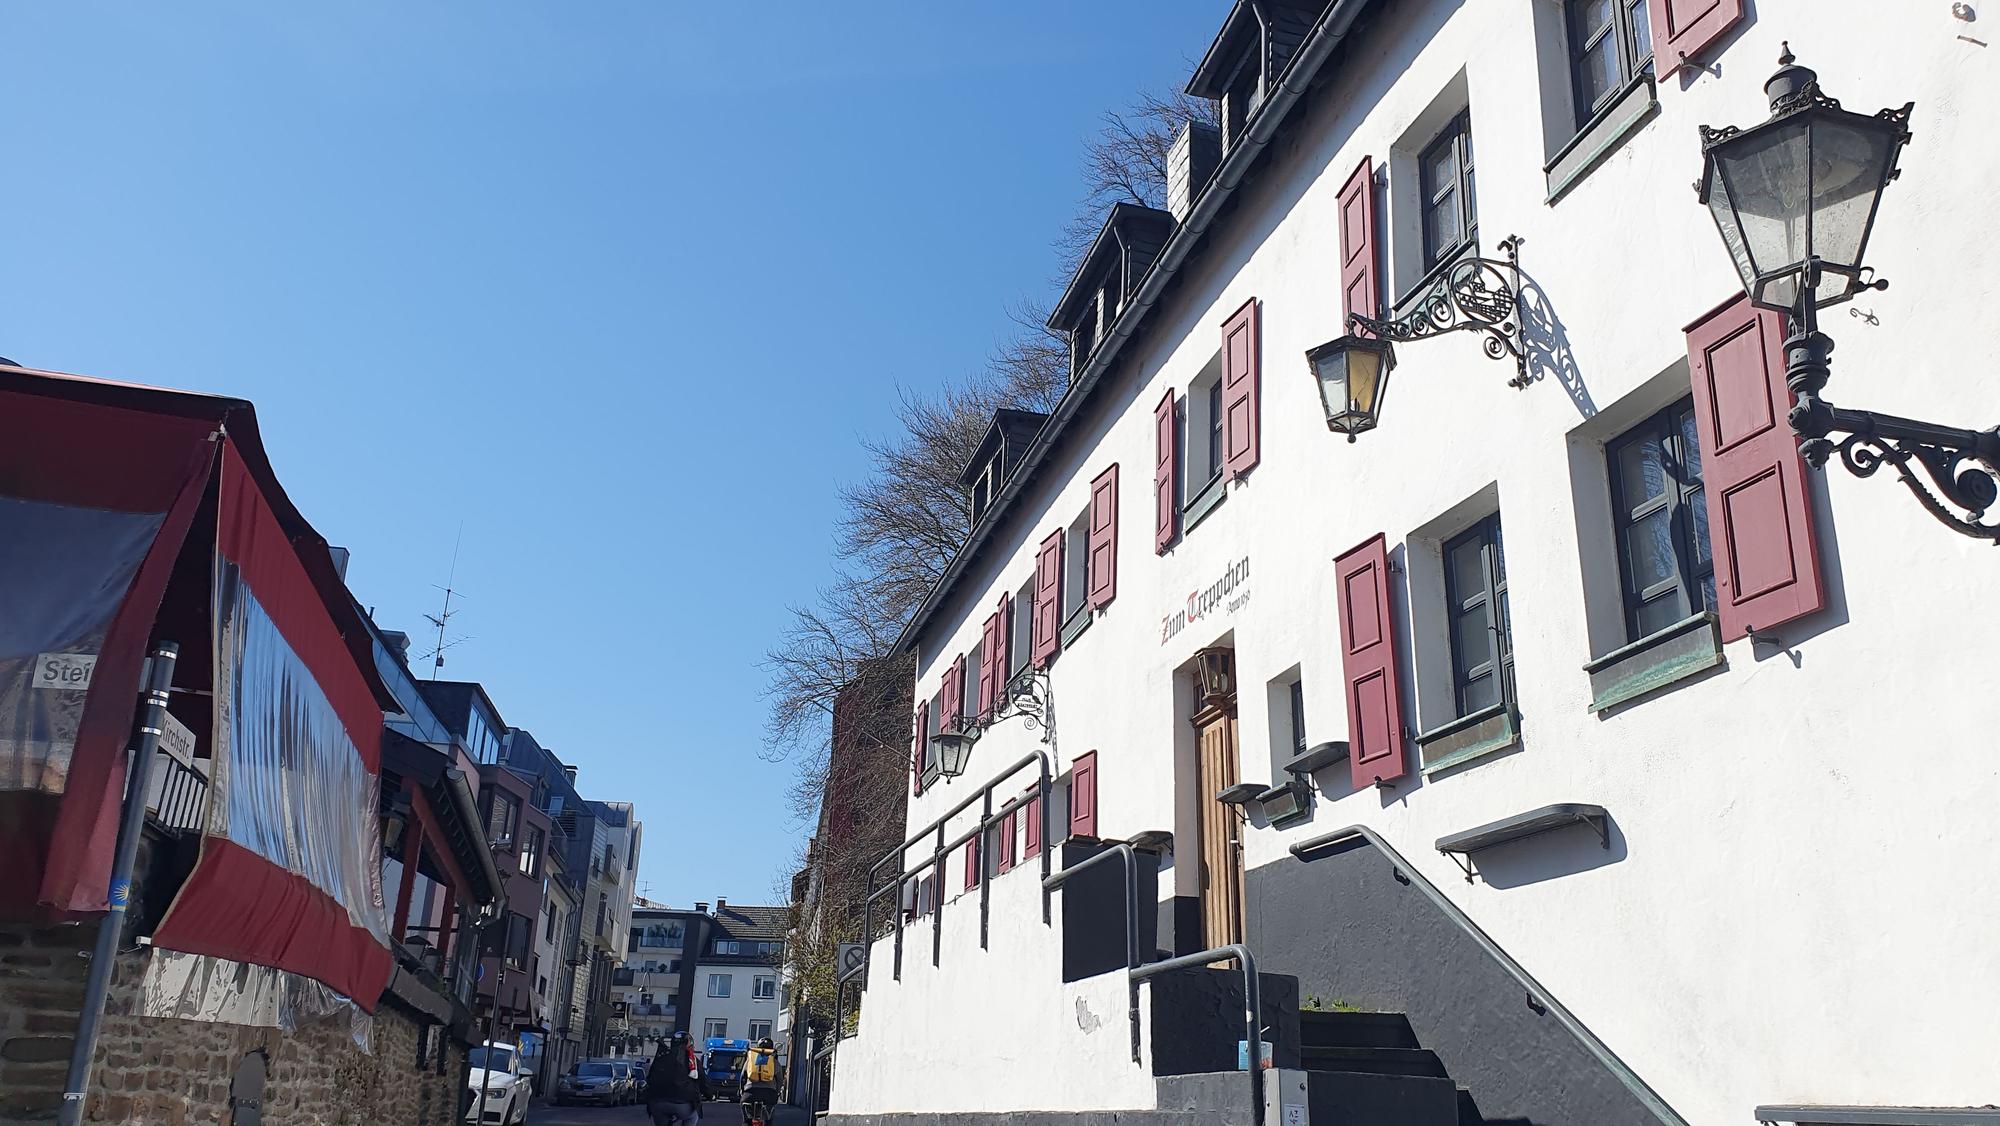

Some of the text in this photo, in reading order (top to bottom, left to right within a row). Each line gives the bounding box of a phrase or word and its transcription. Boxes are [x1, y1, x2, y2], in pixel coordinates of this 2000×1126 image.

[1161, 609, 1185, 647] Zum
[1187, 555, 1250, 623] Treppchen
[43, 660, 92, 682] Stei
